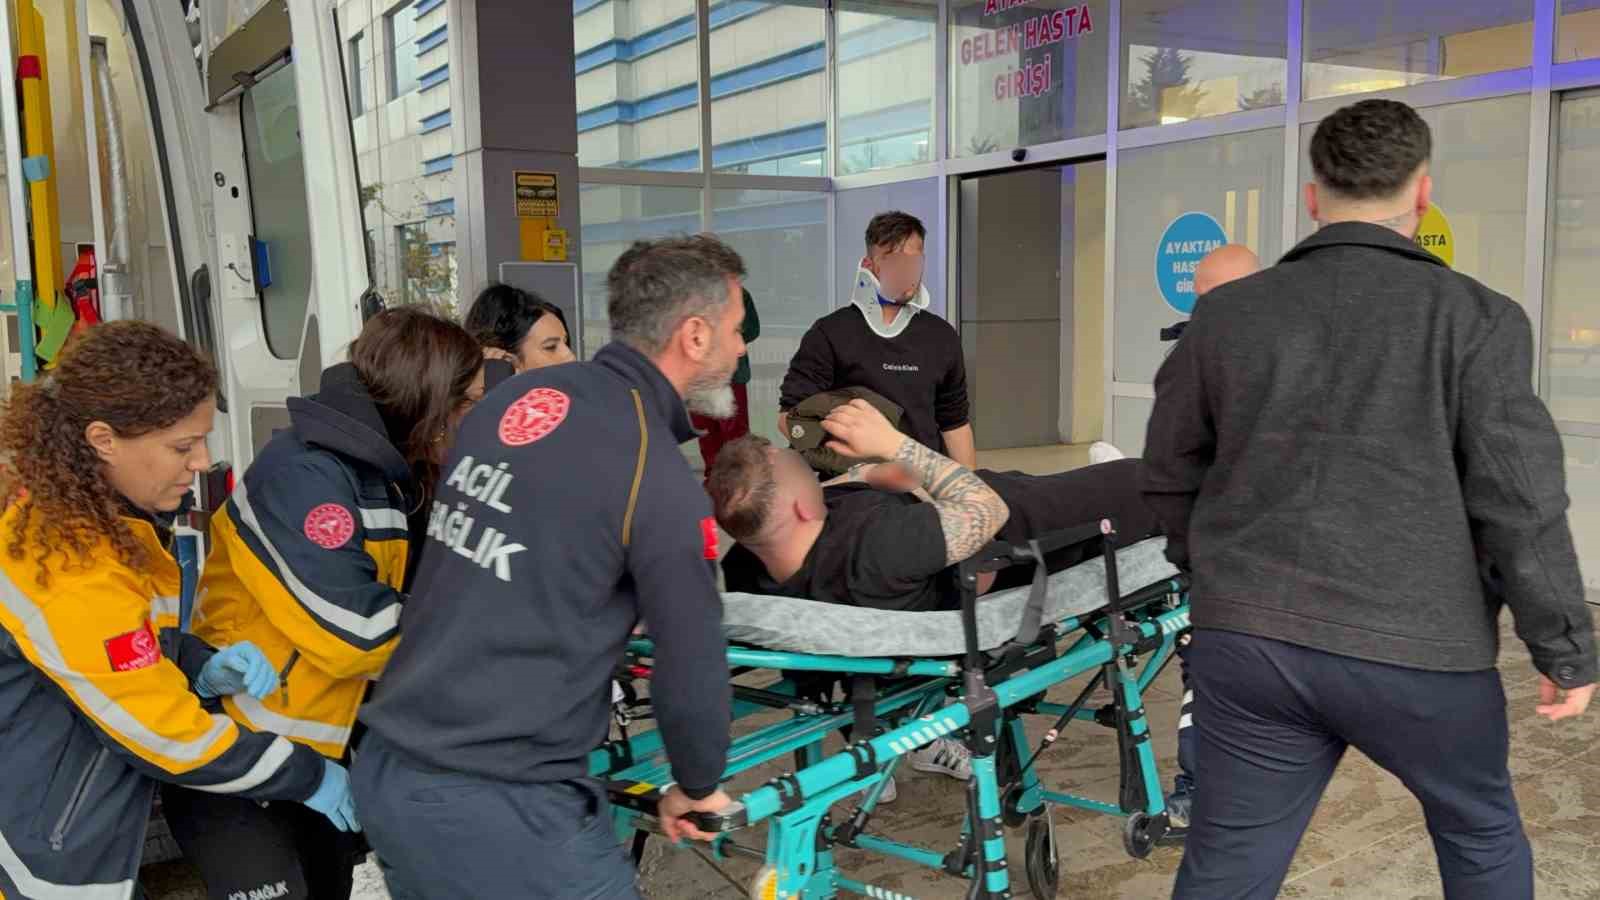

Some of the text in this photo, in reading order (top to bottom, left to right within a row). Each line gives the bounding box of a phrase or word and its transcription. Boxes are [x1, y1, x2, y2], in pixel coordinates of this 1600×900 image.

[961, 3, 1093, 65] GELEN HASTA
[994, 53, 1052, 101] GİRİŞİ
[1414, 233, 1447, 249] ASTA
[1172, 260, 1197, 273] HAS
[1175, 278, 1195, 293] GİR
